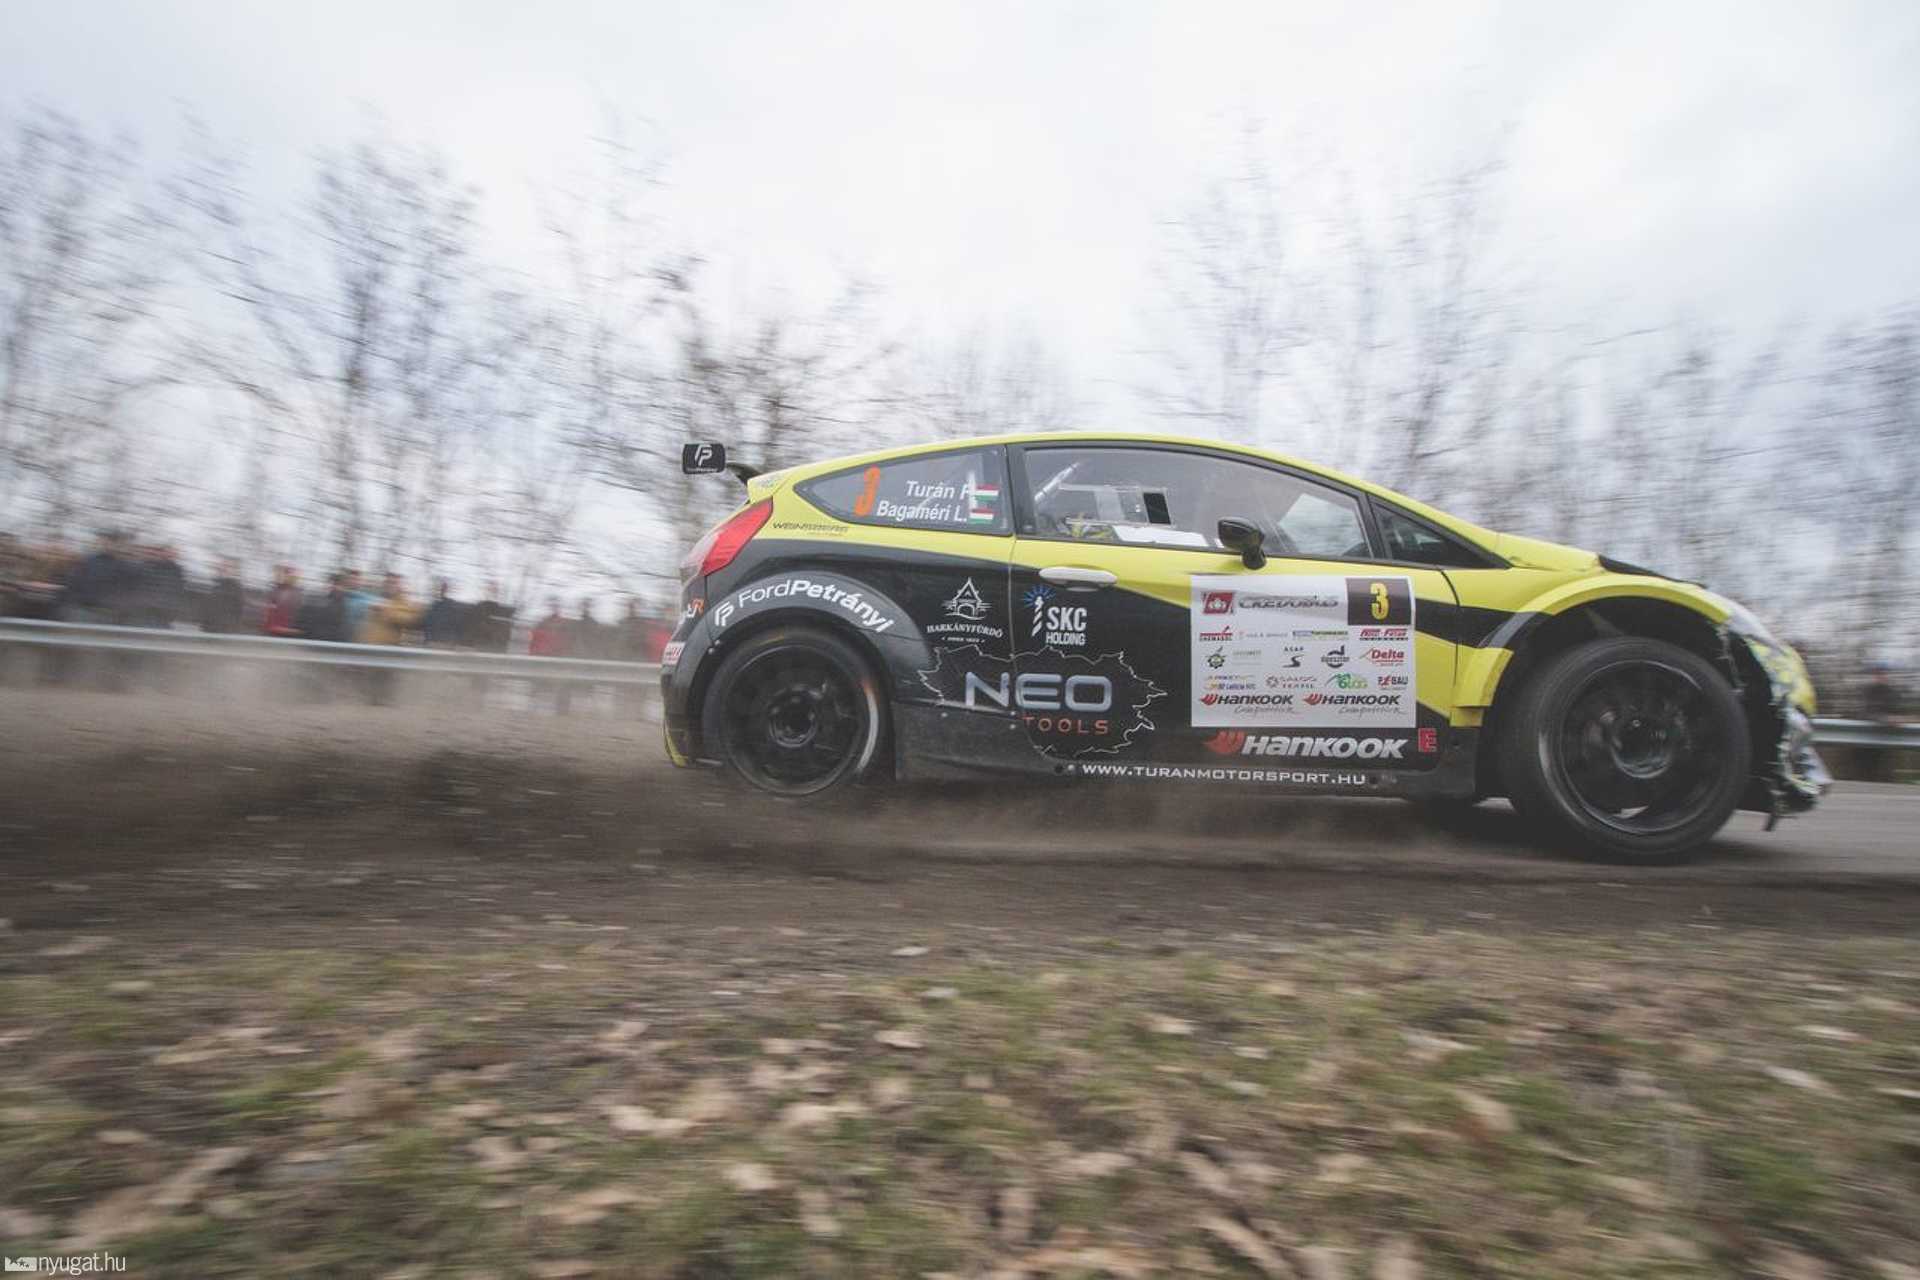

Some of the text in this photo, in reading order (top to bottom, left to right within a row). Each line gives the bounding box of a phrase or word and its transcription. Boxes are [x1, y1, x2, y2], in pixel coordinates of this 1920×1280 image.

[905, 479, 955, 499] Turán
[876, 500, 968, 522] Bagaméri L.
[1369, 582, 1390, 620] 3
[1046, 606, 1088, 631] SKC
[1046, 632, 1086, 646] HOLDING
[1371, 649, 1405, 659] Delta
[965, 671, 1113, 712] NEO
[1022, 716, 1109, 735] TOOLS
[1082, 764, 1366, 785] WWW.TURANMOTORSPORT.HU
